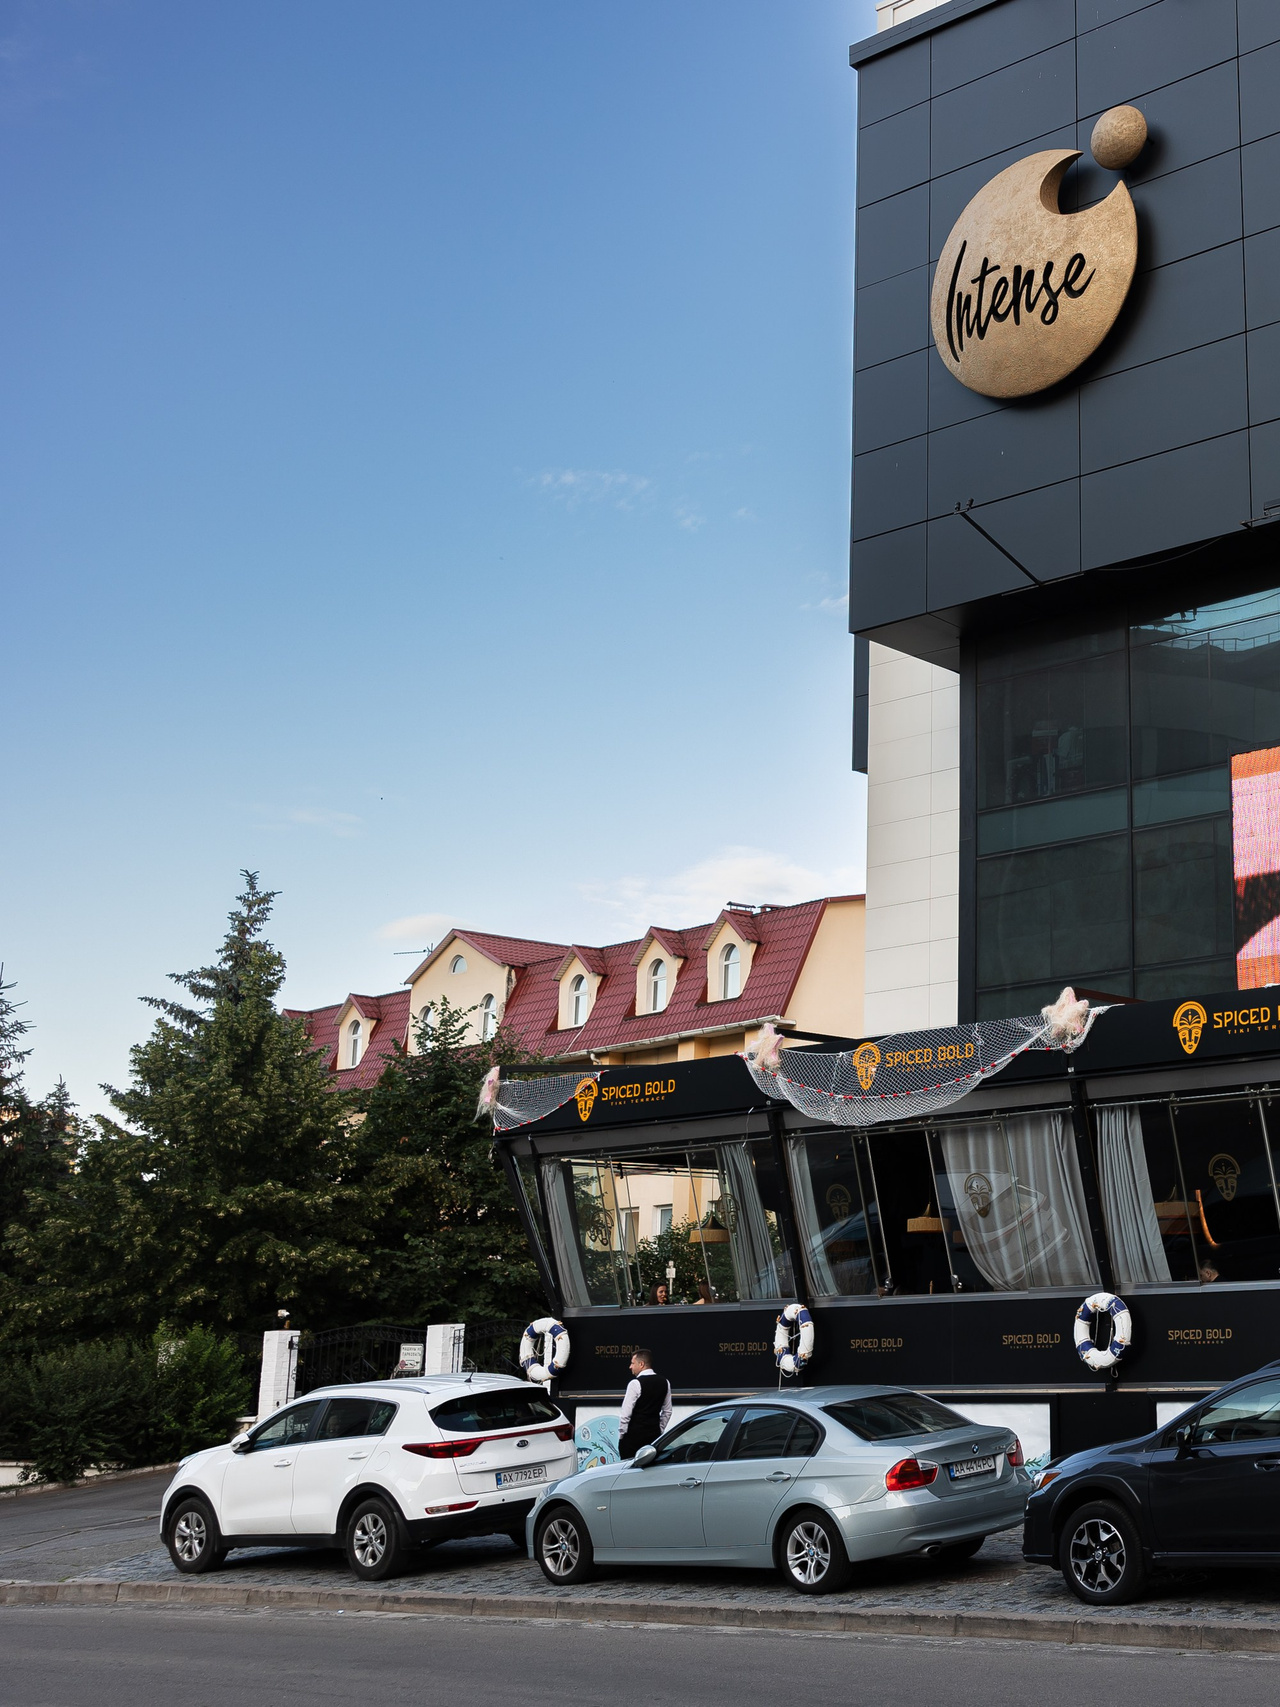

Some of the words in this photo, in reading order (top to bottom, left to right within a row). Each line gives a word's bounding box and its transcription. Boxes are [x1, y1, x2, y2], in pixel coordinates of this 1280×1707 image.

[946, 240, 1096, 363] Intense
[1213, 1004, 1271, 1028] SPICED
[885, 1048, 932, 1067] SPICED
[938, 1043, 974, 1060] GOLD
[602, 1084, 640, 1101] SPICED
[645, 1079, 676, 1095] GOLD
[1002, 1334, 1034, 1345] SPICED
[1037, 1333, 1061, 1344] GOLD
[1168, 1329, 1202, 1340] SPICED
[1206, 1328, 1232, 1339] GOLD
[595, 1345, 619, 1354] SPICED
[719, 1342, 745, 1352] SPICED
[747, 1341, 768, 1351] GOLD
[850, 1339, 879, 1349] SPICED
[881, 1338, 903, 1348] GOLD
[955, 1463, 965, 1474] AA
[966, 1459, 981, 1472] 4414
[982, 1457, 993, 1468] PC
[502, 1474, 514, 1483] AX
[515, 1470, 531, 1481] 7792
[532, 1468, 543, 1478] EP
